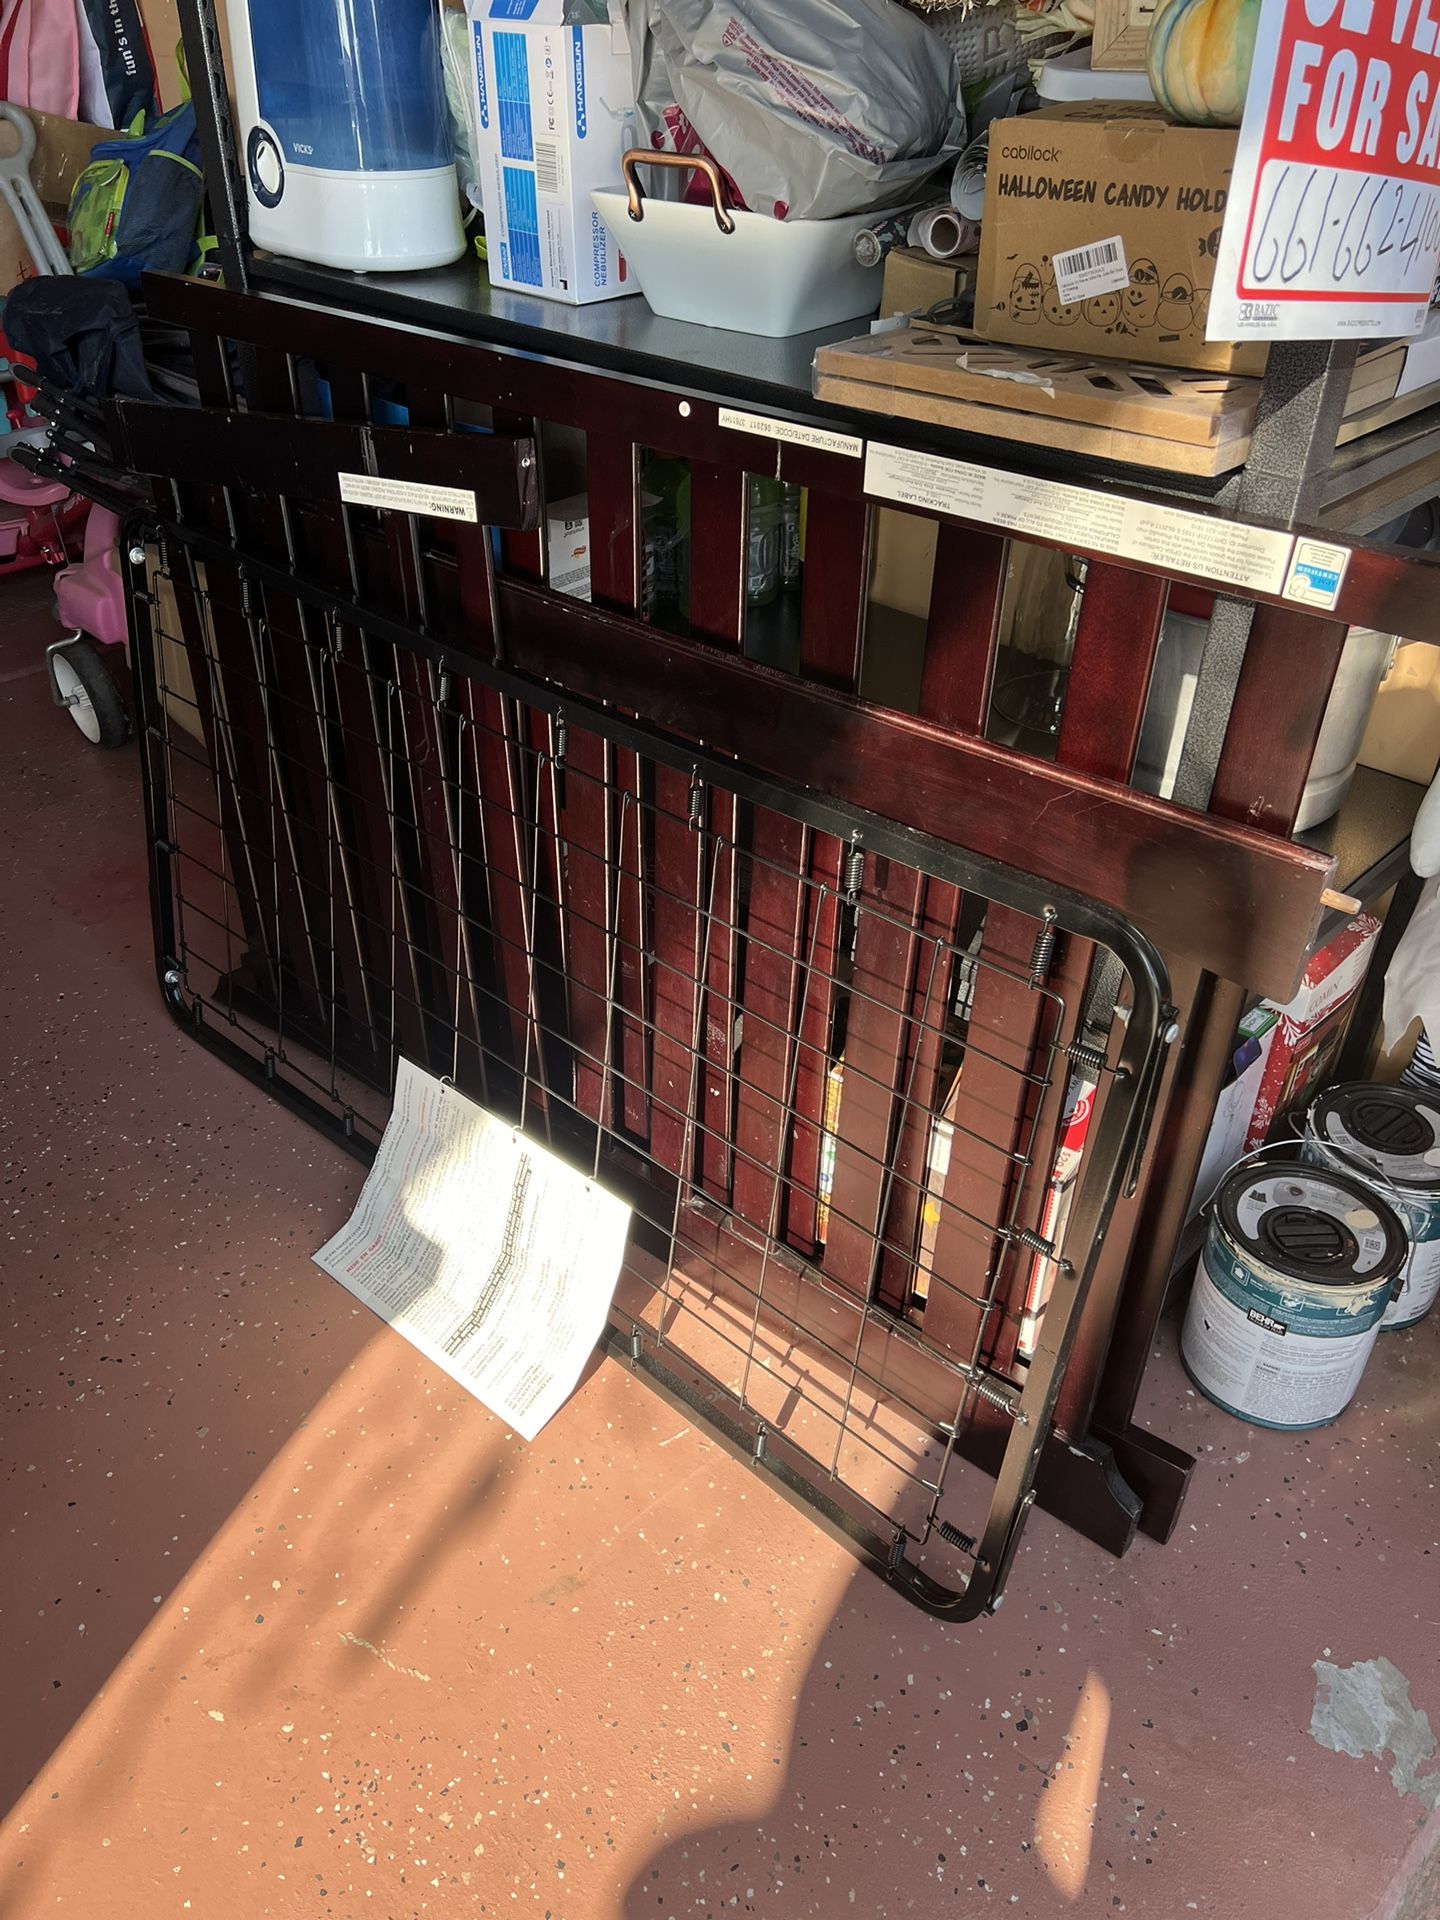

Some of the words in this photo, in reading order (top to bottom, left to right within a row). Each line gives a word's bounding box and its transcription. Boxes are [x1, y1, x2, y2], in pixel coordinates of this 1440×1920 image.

[114, 17, 125, 34] in
[118, 37, 136, 77] fun's
[475, 35, 486, 103] HANGSUN
[575, 41, 584, 112] HANGSUN
[1277, 40, 1391, 156] FOR
[1396, 70, 1440, 168] SA
[292, 142, 314, 155] VICKS
[1001, 145, 1060, 162] cabilock
[998, 174, 1097, 203] HALLOWEEN
[1104, 182, 1169, 209] CANDY
[1176, 187, 1229, 213] HOLD
[592, 211, 600, 287] COMPRESSOR
[599, 226, 607, 286] NEBULIZER
[1254, 303, 1280, 317] BAZIC
[810, 433, 858, 452] MANUFACTURE
[895, 489, 917, 501] LABEL
[918, 495, 950, 509] TRACKING
[428, 501, 465, 516] WARNING:
[1150, 551, 1191, 568] RETAILER:
[1191, 561, 1204, 571] US
[1203, 564, 1250, 582] ATTENTION
[1248, 1309, 1275, 1326] BEHR
